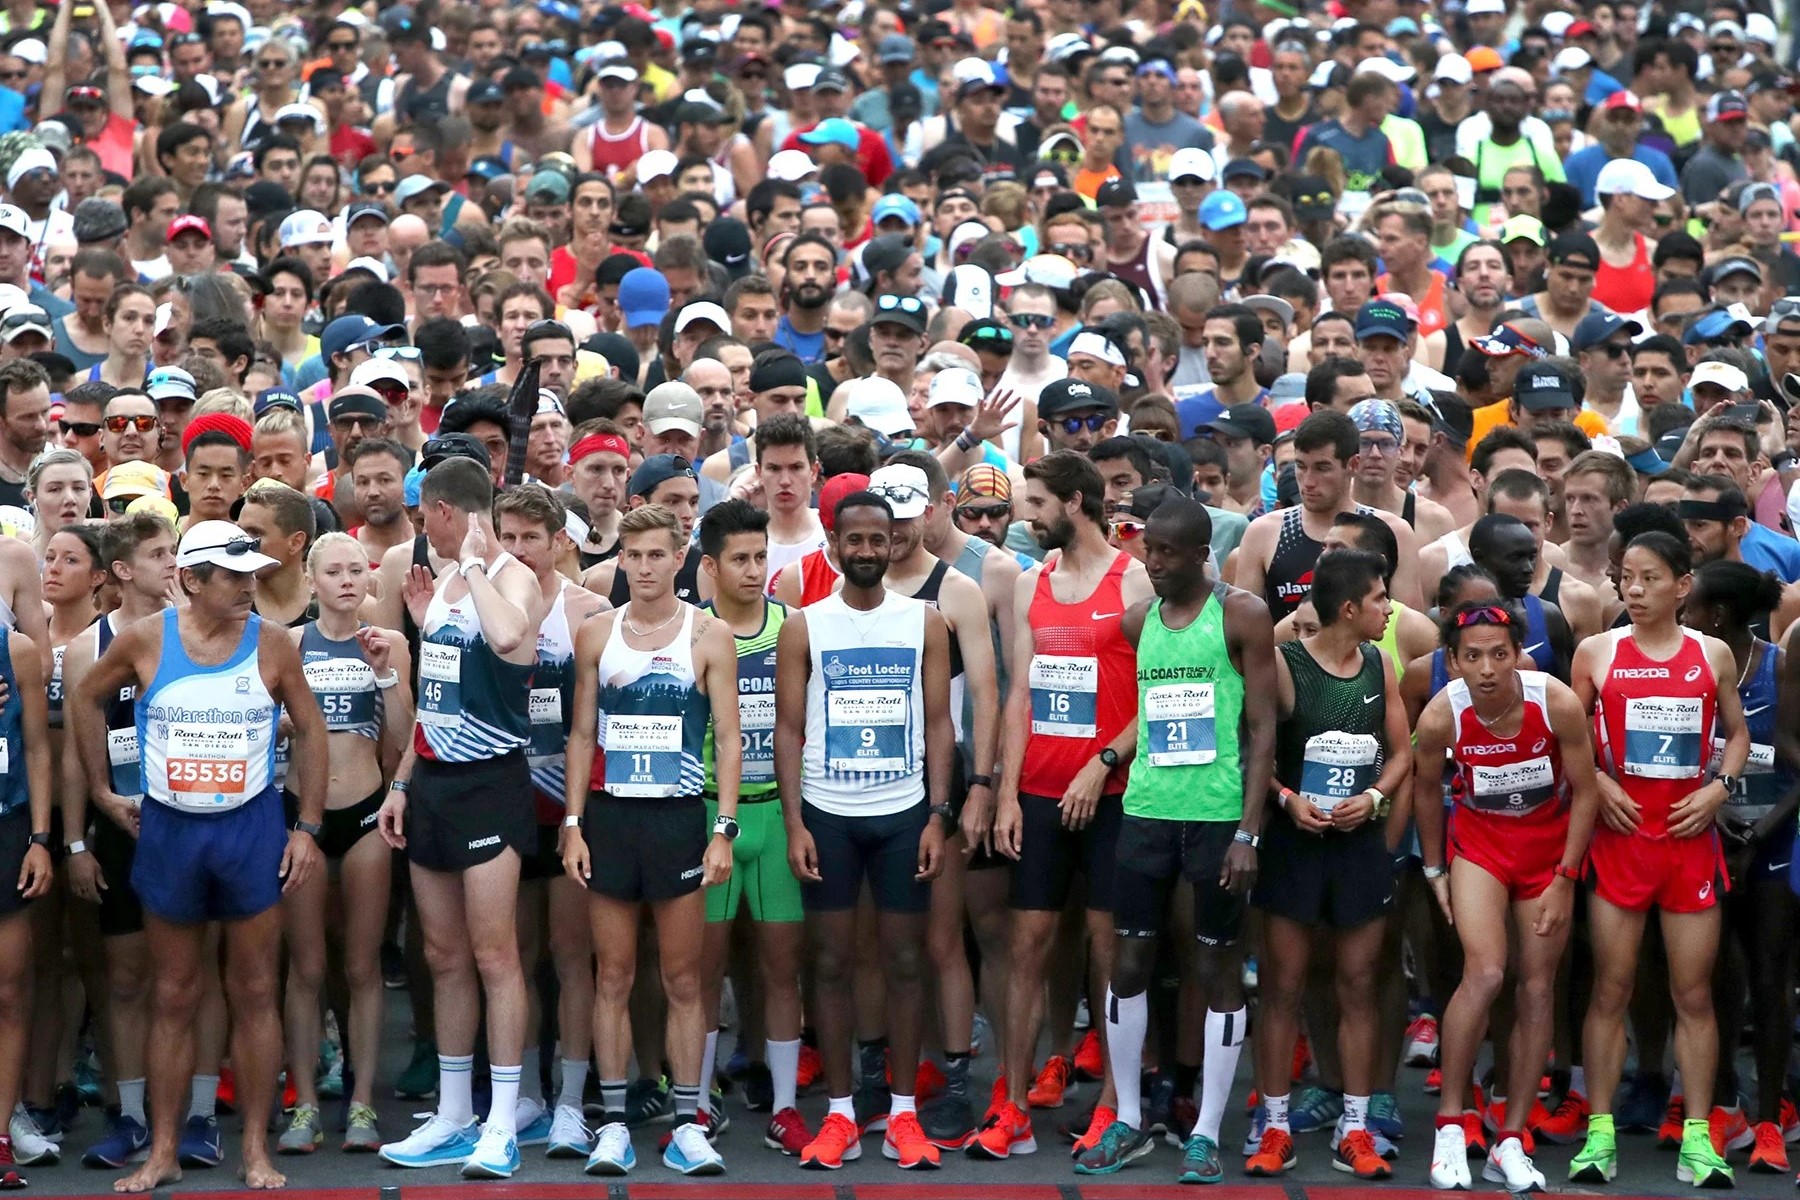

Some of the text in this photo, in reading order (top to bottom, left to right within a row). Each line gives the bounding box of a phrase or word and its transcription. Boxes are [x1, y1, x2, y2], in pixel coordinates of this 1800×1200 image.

[440, 652, 458, 661] Roll
[305, 666, 334, 675] Rock
[346, 664, 372, 672] Roll
[848, 664, 910, 675] Foot Locker
[1034, 661, 1058, 670] Rock
[1068, 663, 1092, 672] Roll
[1150, 668, 1185, 680] COAST
[1613, 668, 1670, 678] mazda
[738, 678, 776, 692] COA
[424, 681, 442, 702] 46
[1183, 690, 1208, 698] Roll
[322, 695, 352, 714] 55
[530, 696, 556, 704] Roll
[834, 696, 864, 705] Rock
[876, 696, 902, 704] Roll
[1048, 692, 1070, 712] 16
[426, 702, 438, 710] ELITE
[1632, 702, 1664, 712] Rock
[1676, 704, 1699, 712] Roll
[168, 706, 242, 724] Marathon
[1049, 714, 1068, 722] ELITE
[612, 722, 640, 730] Rock
[651, 722, 678, 730] Roll
[1166, 722, 1187, 741] 21
[174, 728, 204, 738] Rock
[217, 730, 244, 740] Roll
[860, 728, 876, 748] 9
[113, 736, 137, 744] Roc
[1658, 734, 1673, 754] 7
[1168, 742, 1188, 750] ELITE
[1462, 743, 1516, 756] mazda
[631, 754, 651, 773] 11
[1653, 756, 1676, 764] ELITE
[168, 762, 244, 782] 25536
[1326, 768, 1356, 787] 28
[1478, 772, 1508, 780] Rock
[1520, 764, 1546, 774] Roll
[630, 774, 653, 782] ELITE
[1328, 788, 1352, 796] ELITE
[1509, 793, 1524, 804] 8
[468, 836, 490, 849] HOKA
